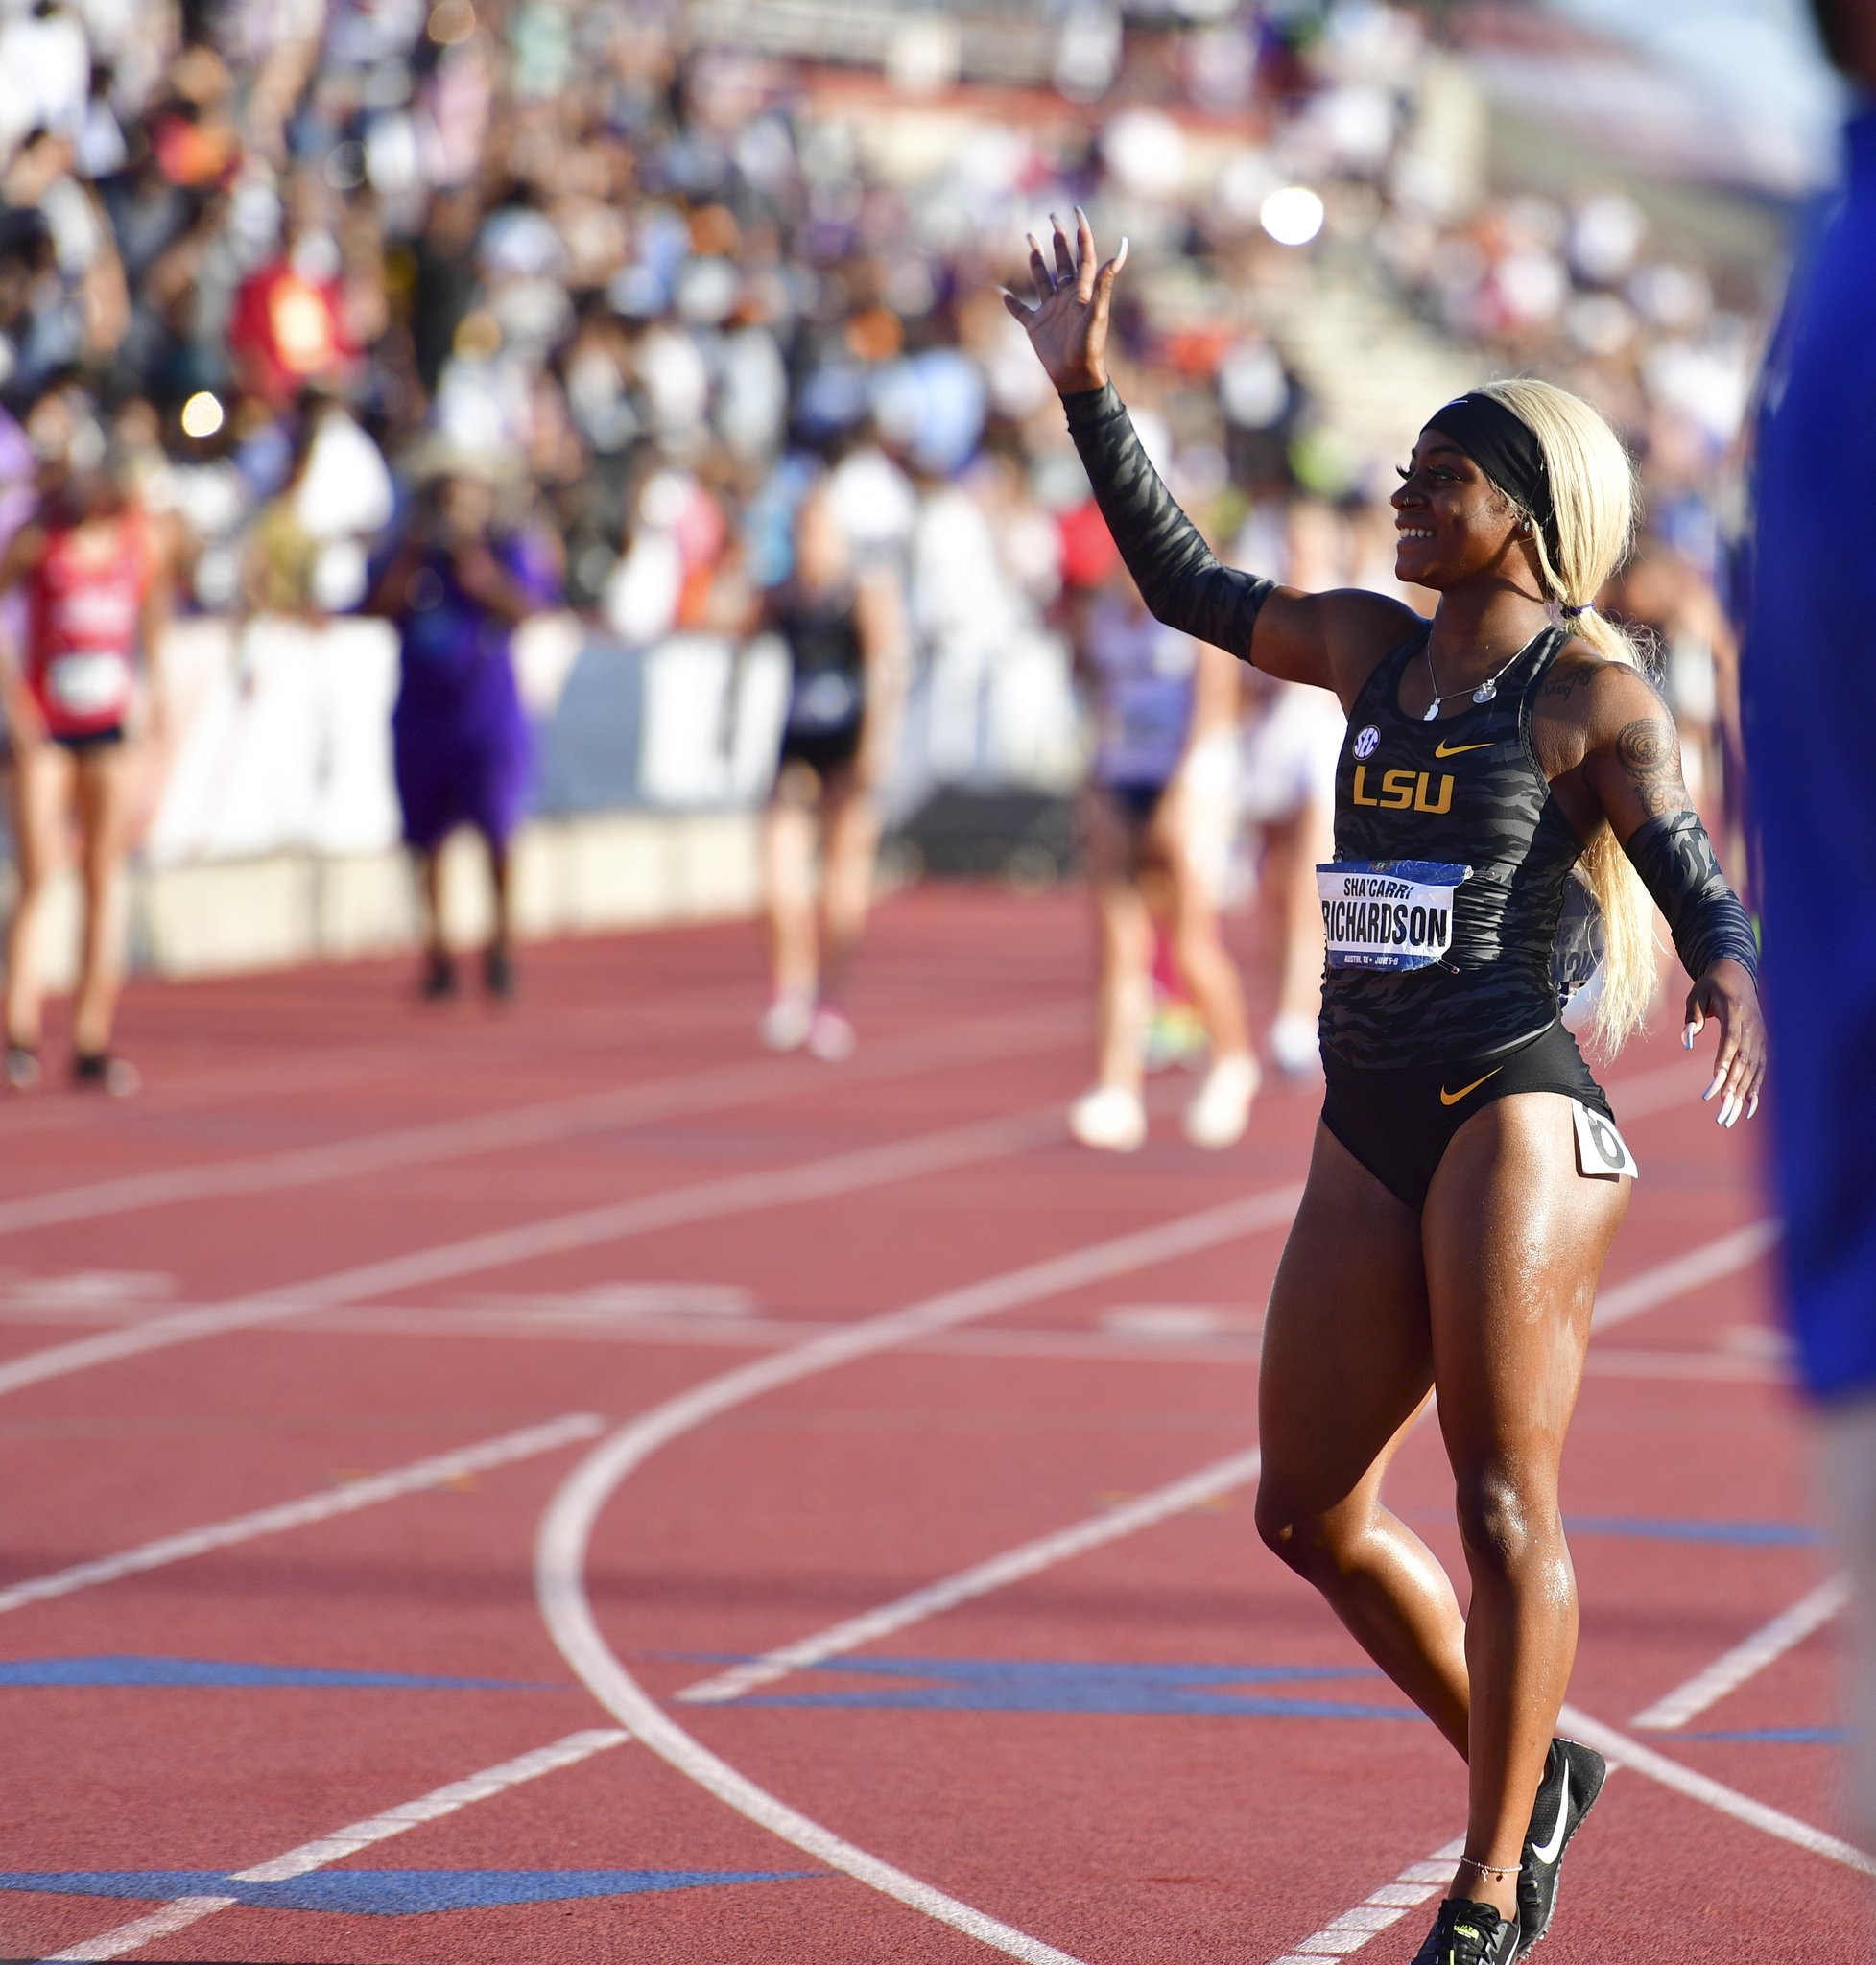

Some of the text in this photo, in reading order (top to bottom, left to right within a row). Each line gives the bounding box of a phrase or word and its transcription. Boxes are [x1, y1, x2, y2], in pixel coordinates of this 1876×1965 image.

[1354, 727, 1379, 758] SEC
[1354, 765, 1455, 815] LSU
[1343, 877, 1415, 900] SHA'CARRI
[1322, 900, 1448, 948] RICHARDSON
[1363, 955, 1369, 964] TX
[1374, 956, 1389, 966] JUNE
